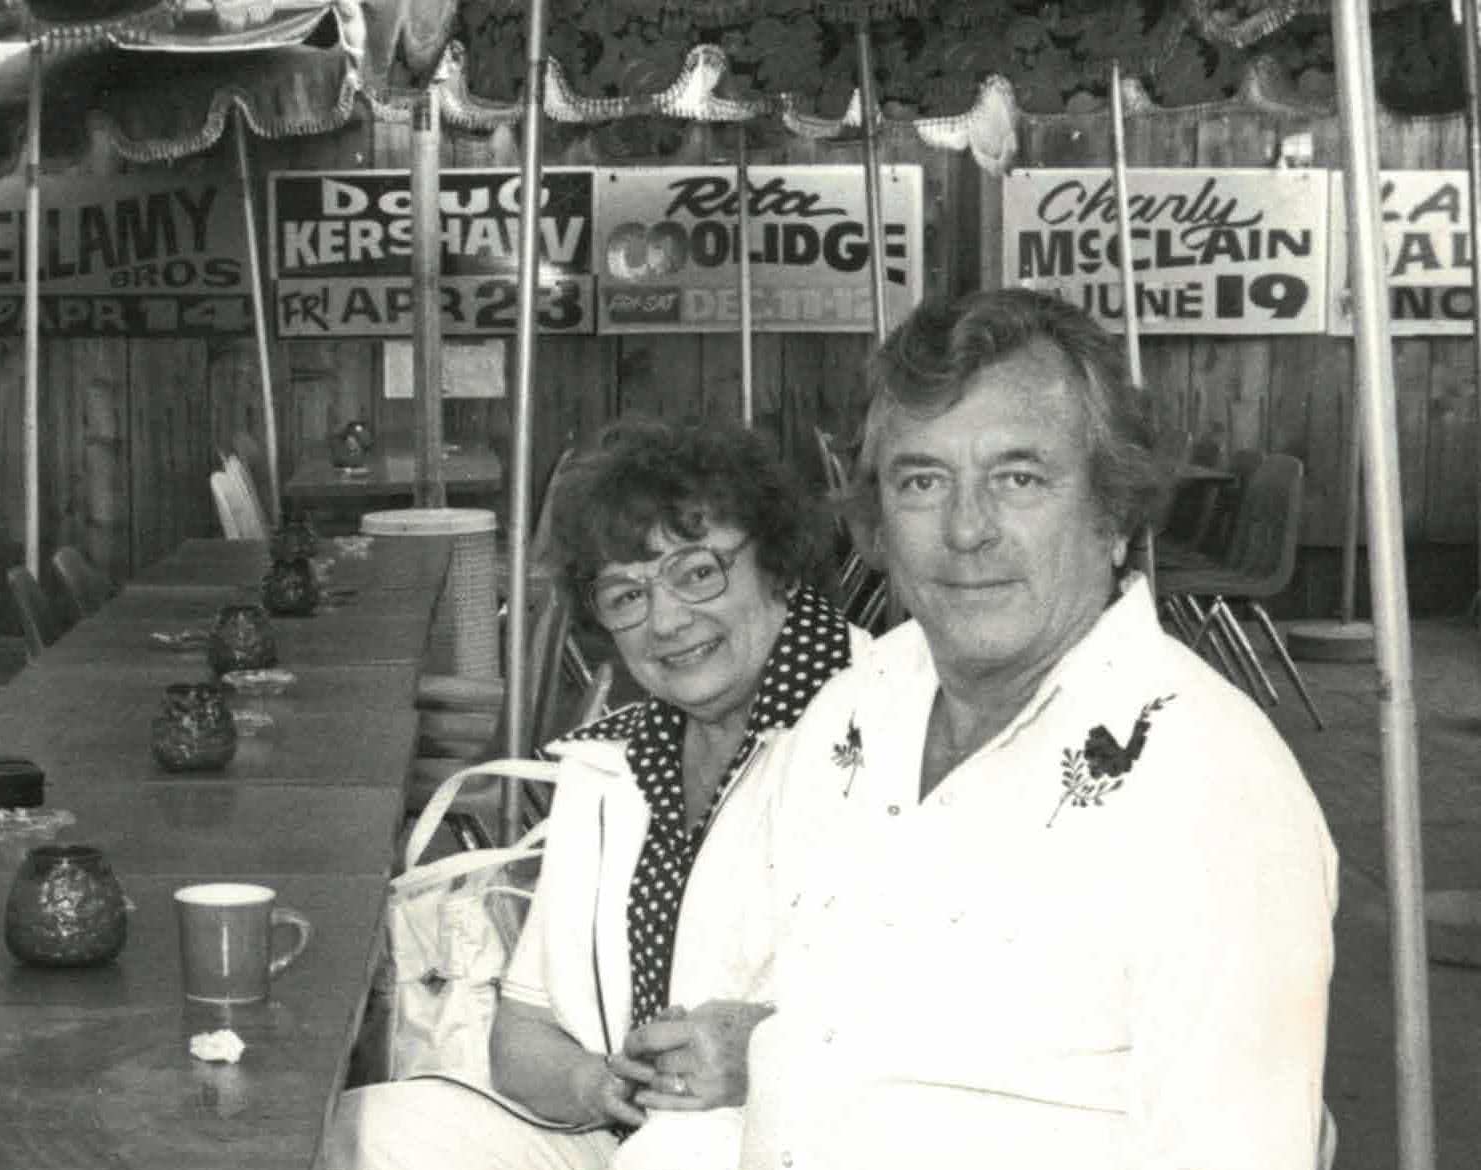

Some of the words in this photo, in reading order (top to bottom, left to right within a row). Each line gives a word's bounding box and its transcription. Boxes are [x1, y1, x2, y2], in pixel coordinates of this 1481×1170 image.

[666, 175, 848, 217] Rita
[1037, 177, 1263, 251] Charly
[283, 216, 585, 268] KERSHAW
[606, 221, 906, 286] COOLIDGE
[110, 258, 243, 288] BROS
[1218, 273, 1308, 318] 19
[340, 287, 466, 323] APR
[474, 280, 583, 329] 23
